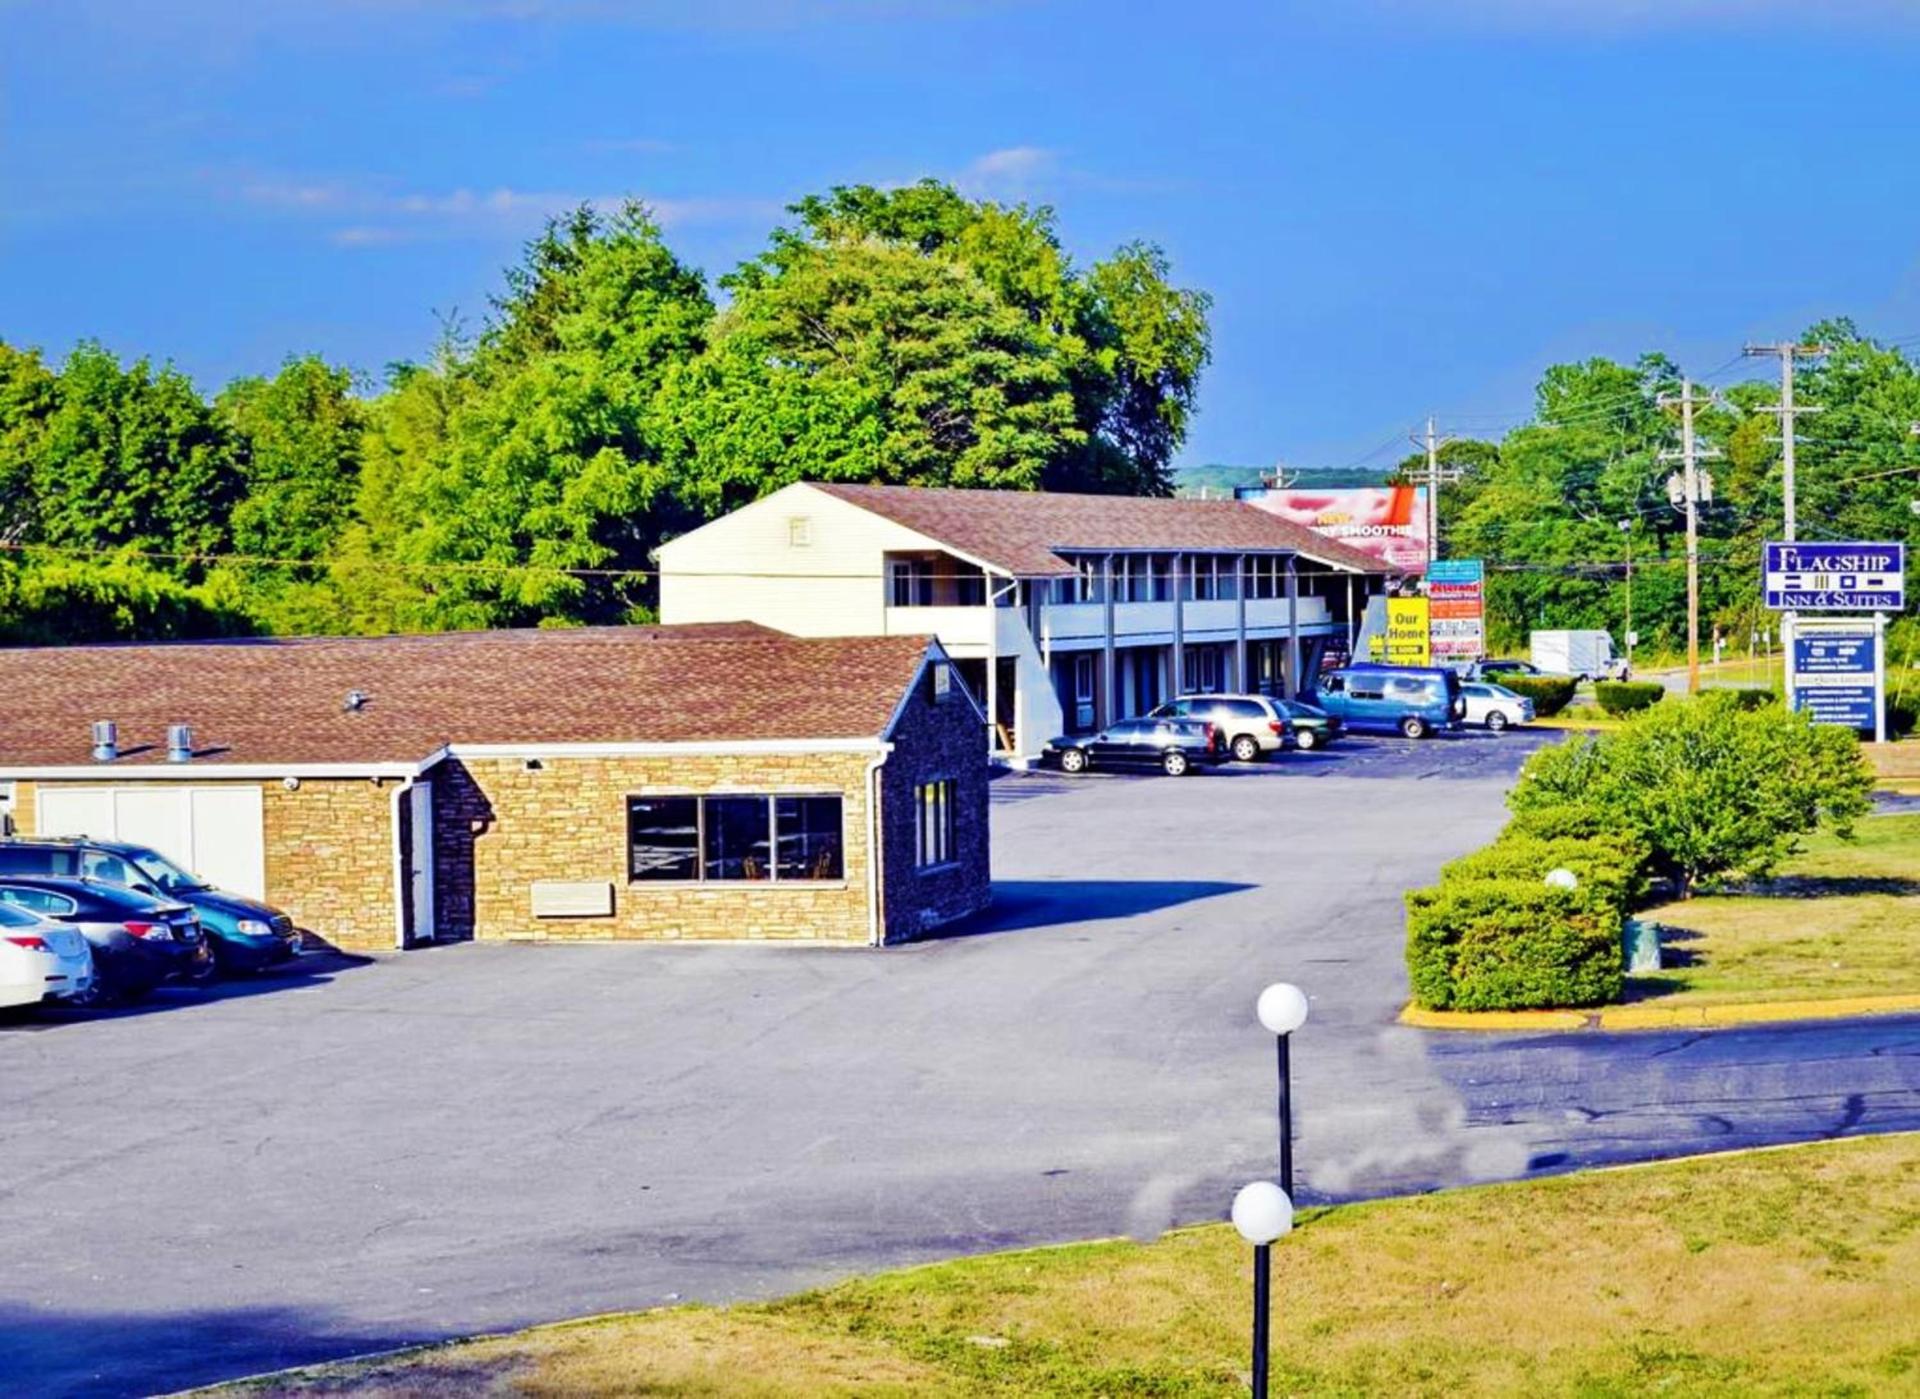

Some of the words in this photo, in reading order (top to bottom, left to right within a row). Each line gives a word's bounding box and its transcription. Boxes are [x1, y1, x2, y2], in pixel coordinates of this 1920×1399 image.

[1779, 548, 1891, 571] FLAGSHIP
[1779, 591, 1811, 606] INN
[1832, 591, 1892, 607] SUITES
[1395, 613, 1418, 625] Our
[1388, 627, 1426, 639] Home
